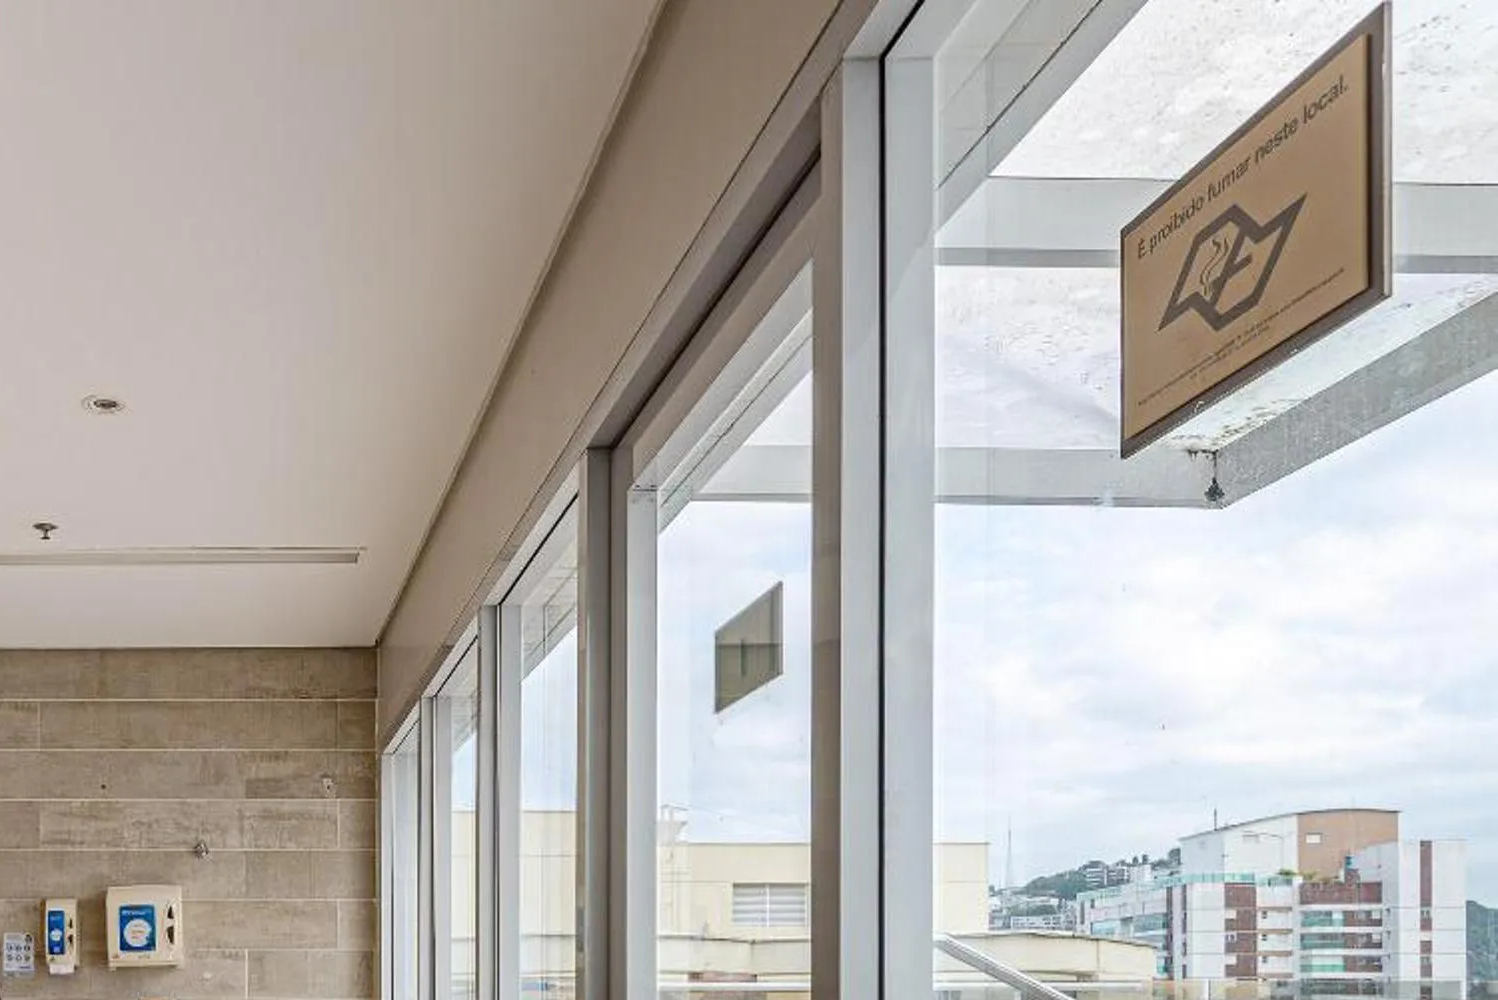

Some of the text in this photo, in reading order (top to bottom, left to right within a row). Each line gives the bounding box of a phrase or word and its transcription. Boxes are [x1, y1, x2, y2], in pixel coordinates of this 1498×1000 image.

[1137, 74, 1350, 259] É proibido fumar neste local.
